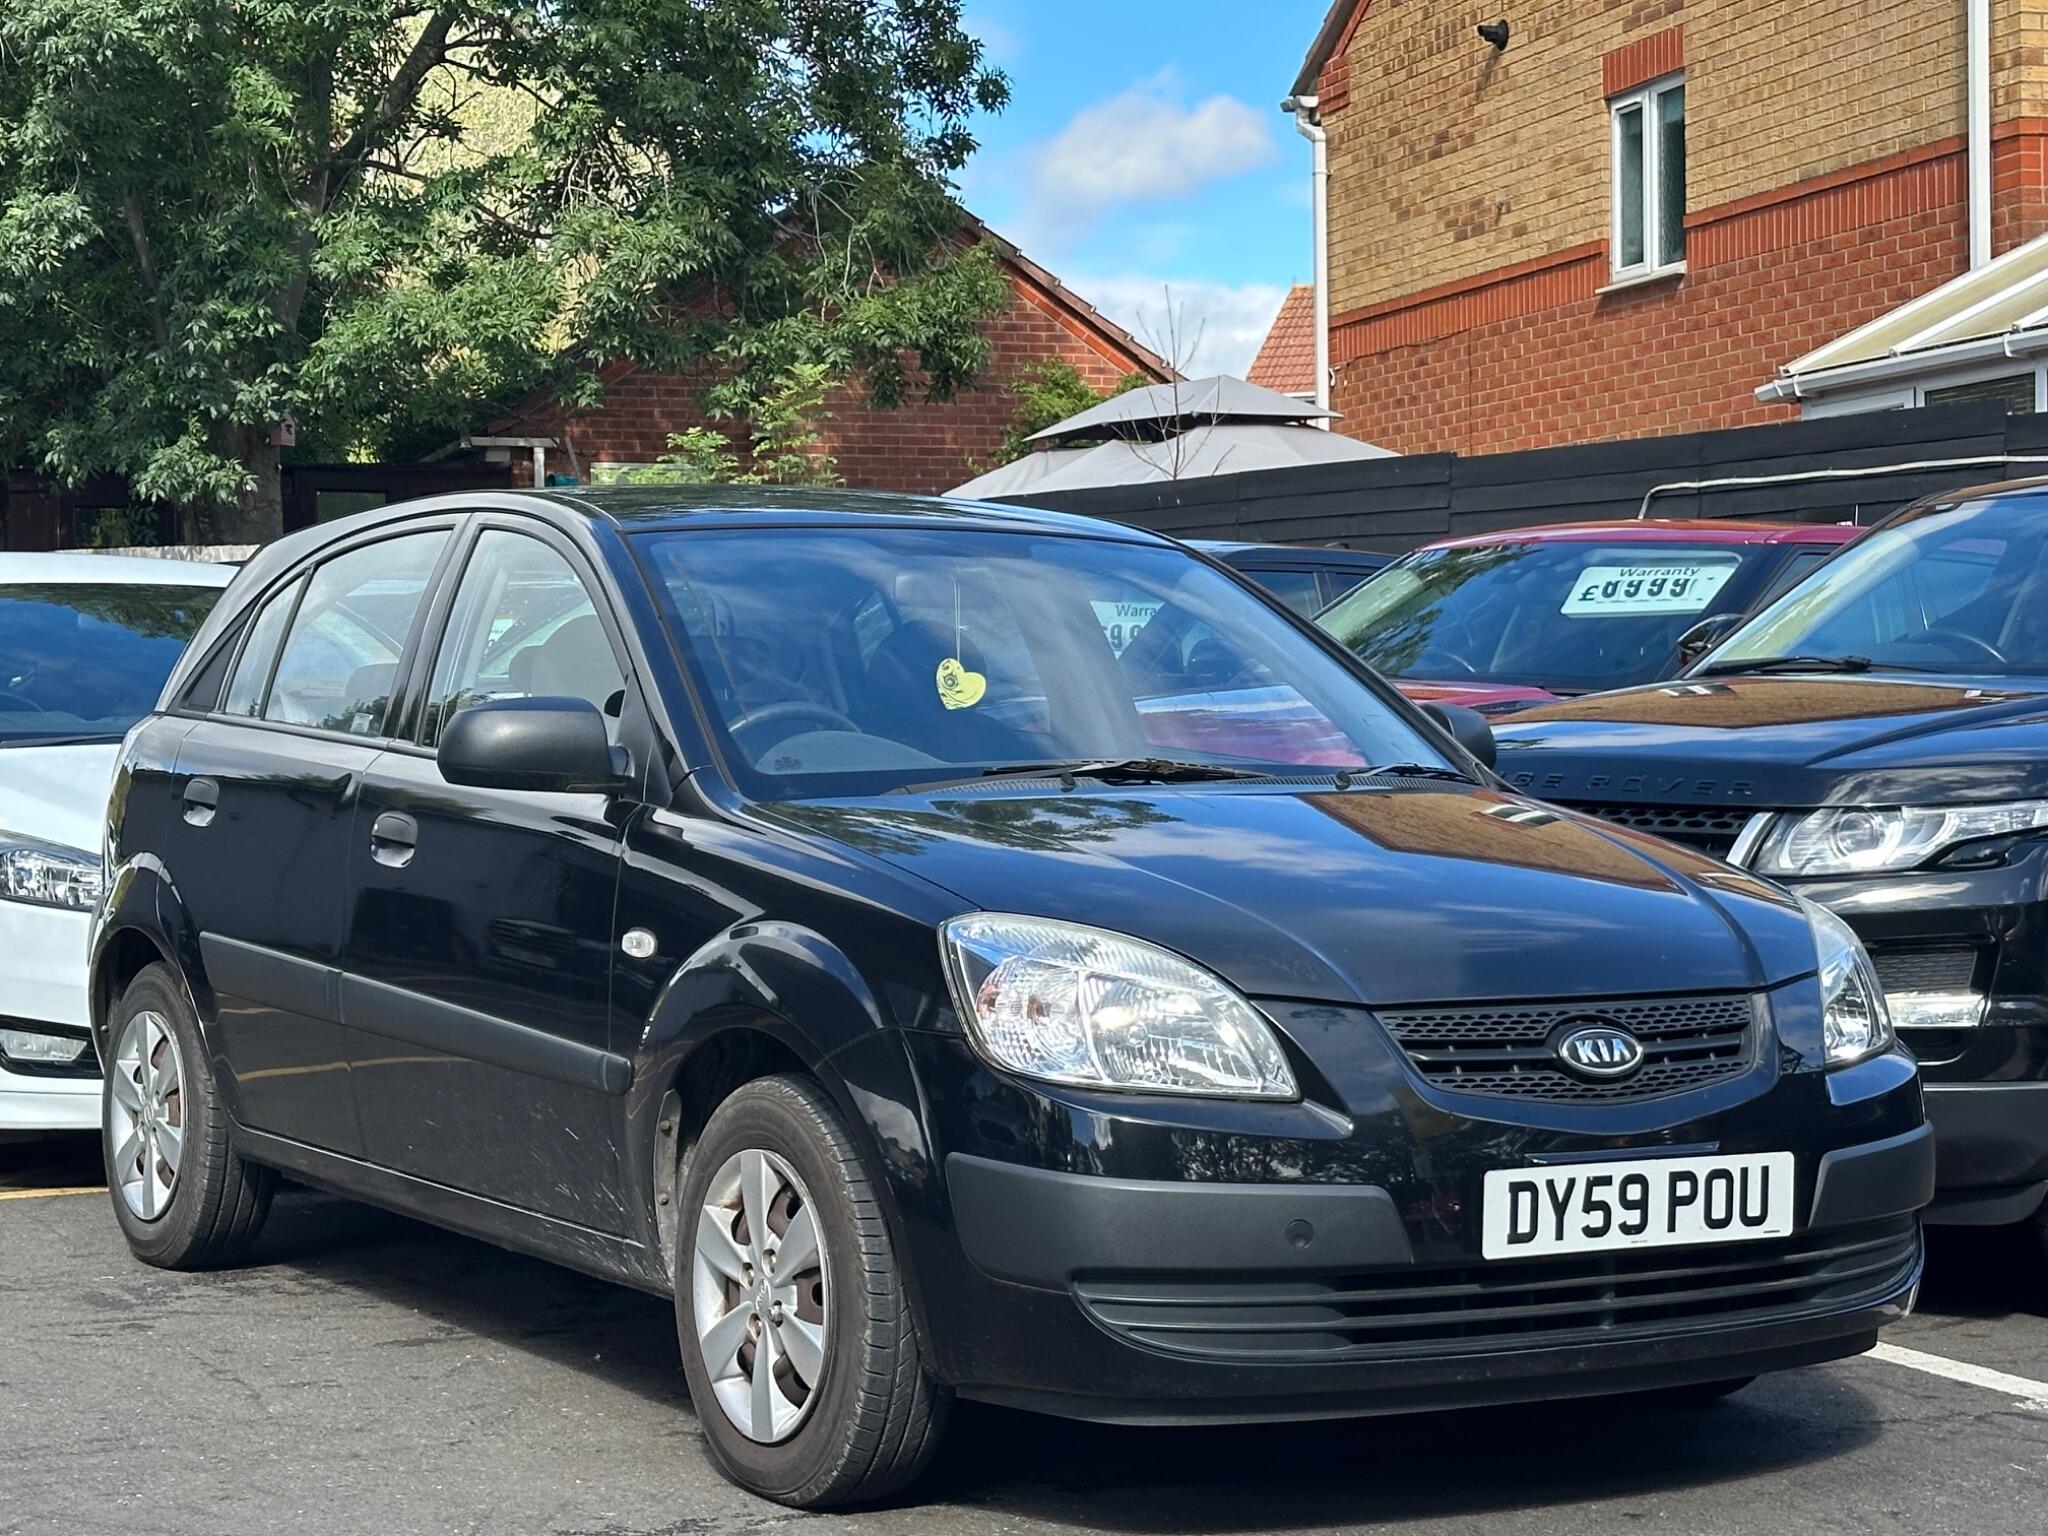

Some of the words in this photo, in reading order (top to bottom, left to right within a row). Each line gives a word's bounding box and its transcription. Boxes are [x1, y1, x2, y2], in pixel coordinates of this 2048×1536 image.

[1619, 567, 1700, 577] Warranty
[1116, 605, 1156, 617] Warra
[1585, 774, 1753, 795] ROVER
[1574, 1038, 1632, 1063] KIA
[1506, 1173, 1650, 1245] DY59
[1666, 1165, 1770, 1233] POU
